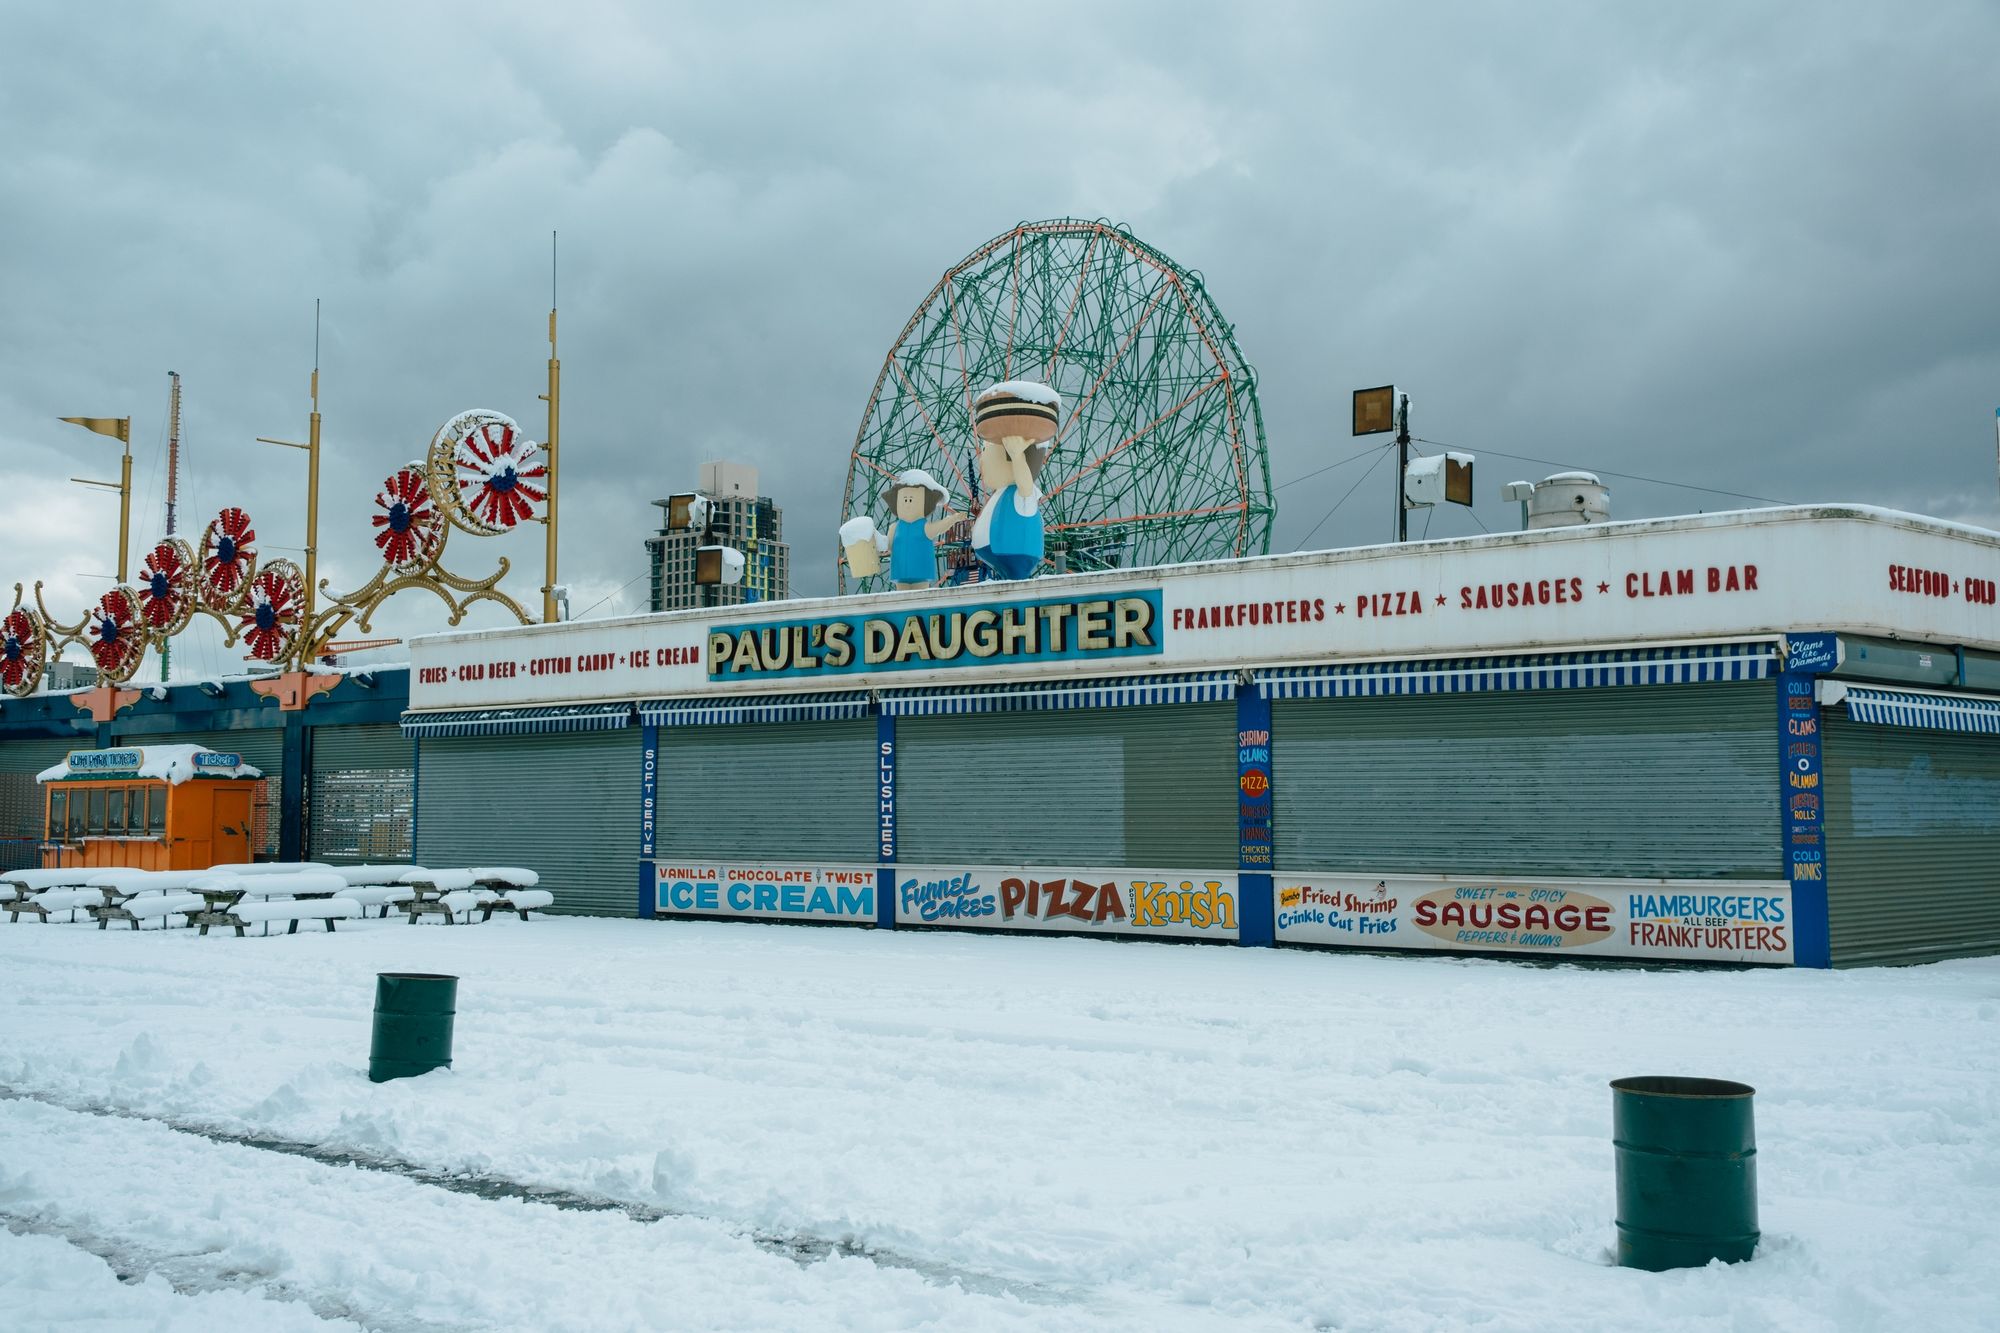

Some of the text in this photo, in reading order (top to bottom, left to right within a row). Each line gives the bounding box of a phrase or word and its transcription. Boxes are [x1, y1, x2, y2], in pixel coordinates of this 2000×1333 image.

[1889, 564, 1996, 605] SEAFOOD COLD
[1173, 564, 1759, 630] FRANKFURTERS PIZZA SAUSAGES CLAM BAR
[708, 597, 1157, 675] PAUL'S DAUGHTER
[1801, 650, 1818, 659] like
[419, 646, 699, 684] FRIES COLD BEER COTTON CANDY ICE CREAM
[1788, 682, 1811, 695] COLD
[1788, 718, 1817, 736] CLAMS
[1239, 730, 1269, 748] SHRIMP
[200, 752, 236, 766] Tickets
[1239, 748, 1268, 763] CLAMS
[1240, 776, 1269, 790] PIZZA
[643, 749, 654, 854] SOFT SERVE
[881, 742, 893, 856] SLUSHIES
[1794, 810, 1816, 820] ROLLS
[1241, 845, 1270, 854] CHICKEN
[1793, 851, 1820, 861] COLD
[1242, 855, 1271, 864] TENDERS
[659, 867, 874, 885] VANILLA CHOCOLATE TWIST
[1794, 863, 1822, 880] DRINKS
[659, 881, 874, 916] ICE CREAM
[1000, 877, 1127, 925] PIZZA
[1302, 886, 1341, 907] Fried
[1344, 893, 1398, 915] Shrimp
[1454, 887, 1496, 900] SWEET
[1528, 888, 1567, 904] SPICY
[1131, 881, 1239, 929] Knish
[1629, 894, 1785, 923] HAMBURGERS
[1277, 908, 1398, 935] Crinkle Cut Fries
[1415, 899, 1611, 932] SAUSAGE
[1683, 917, 1728, 927] ALL BEEF
[1455, 930, 1562, 948] PEPPERS & ONIONS
[1630, 922, 1787, 952] FRANKFURTERS
